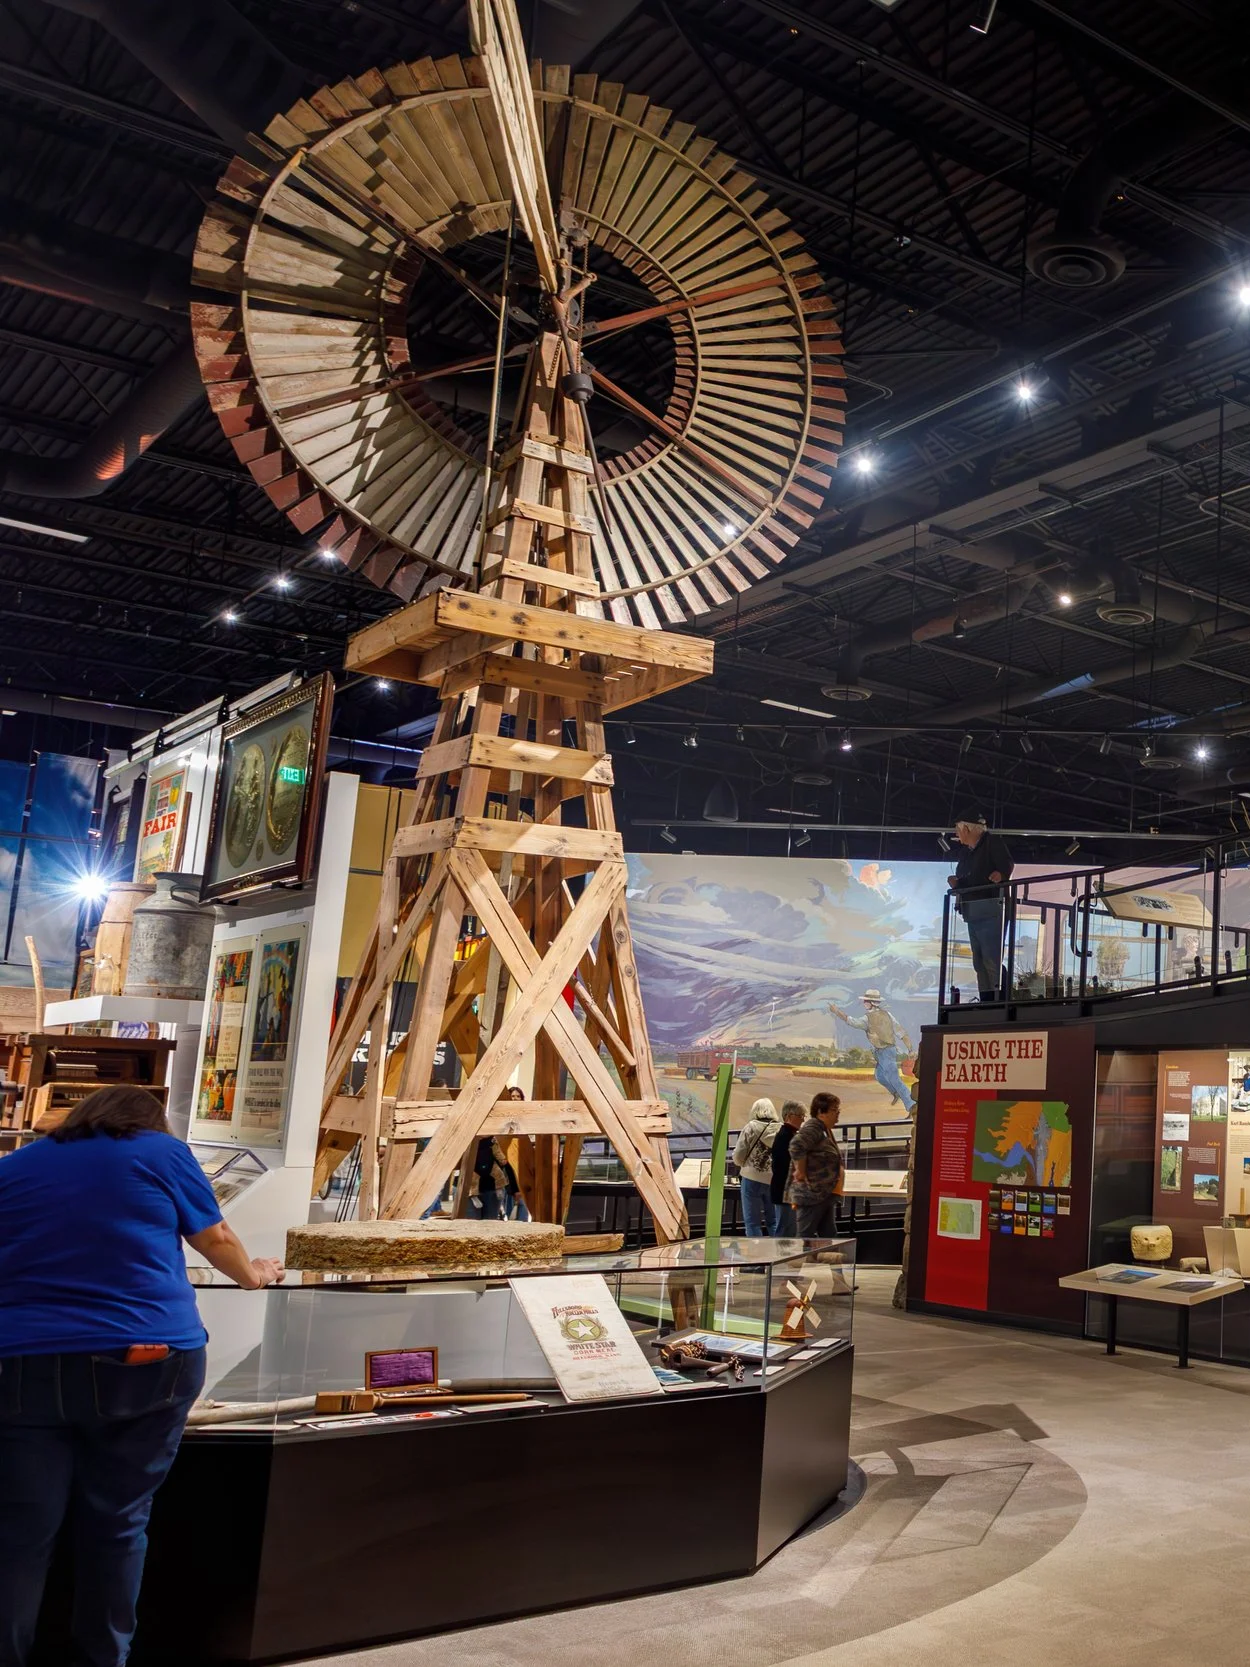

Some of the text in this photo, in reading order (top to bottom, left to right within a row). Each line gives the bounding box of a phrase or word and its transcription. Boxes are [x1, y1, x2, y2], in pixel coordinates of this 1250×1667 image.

[143, 812, 178, 838] FAIR
[946, 1039, 1044, 1060] USING THE
[945, 1063, 1008, 1083] EARTH
[567, 1341, 616, 1350] WHITE STAR
